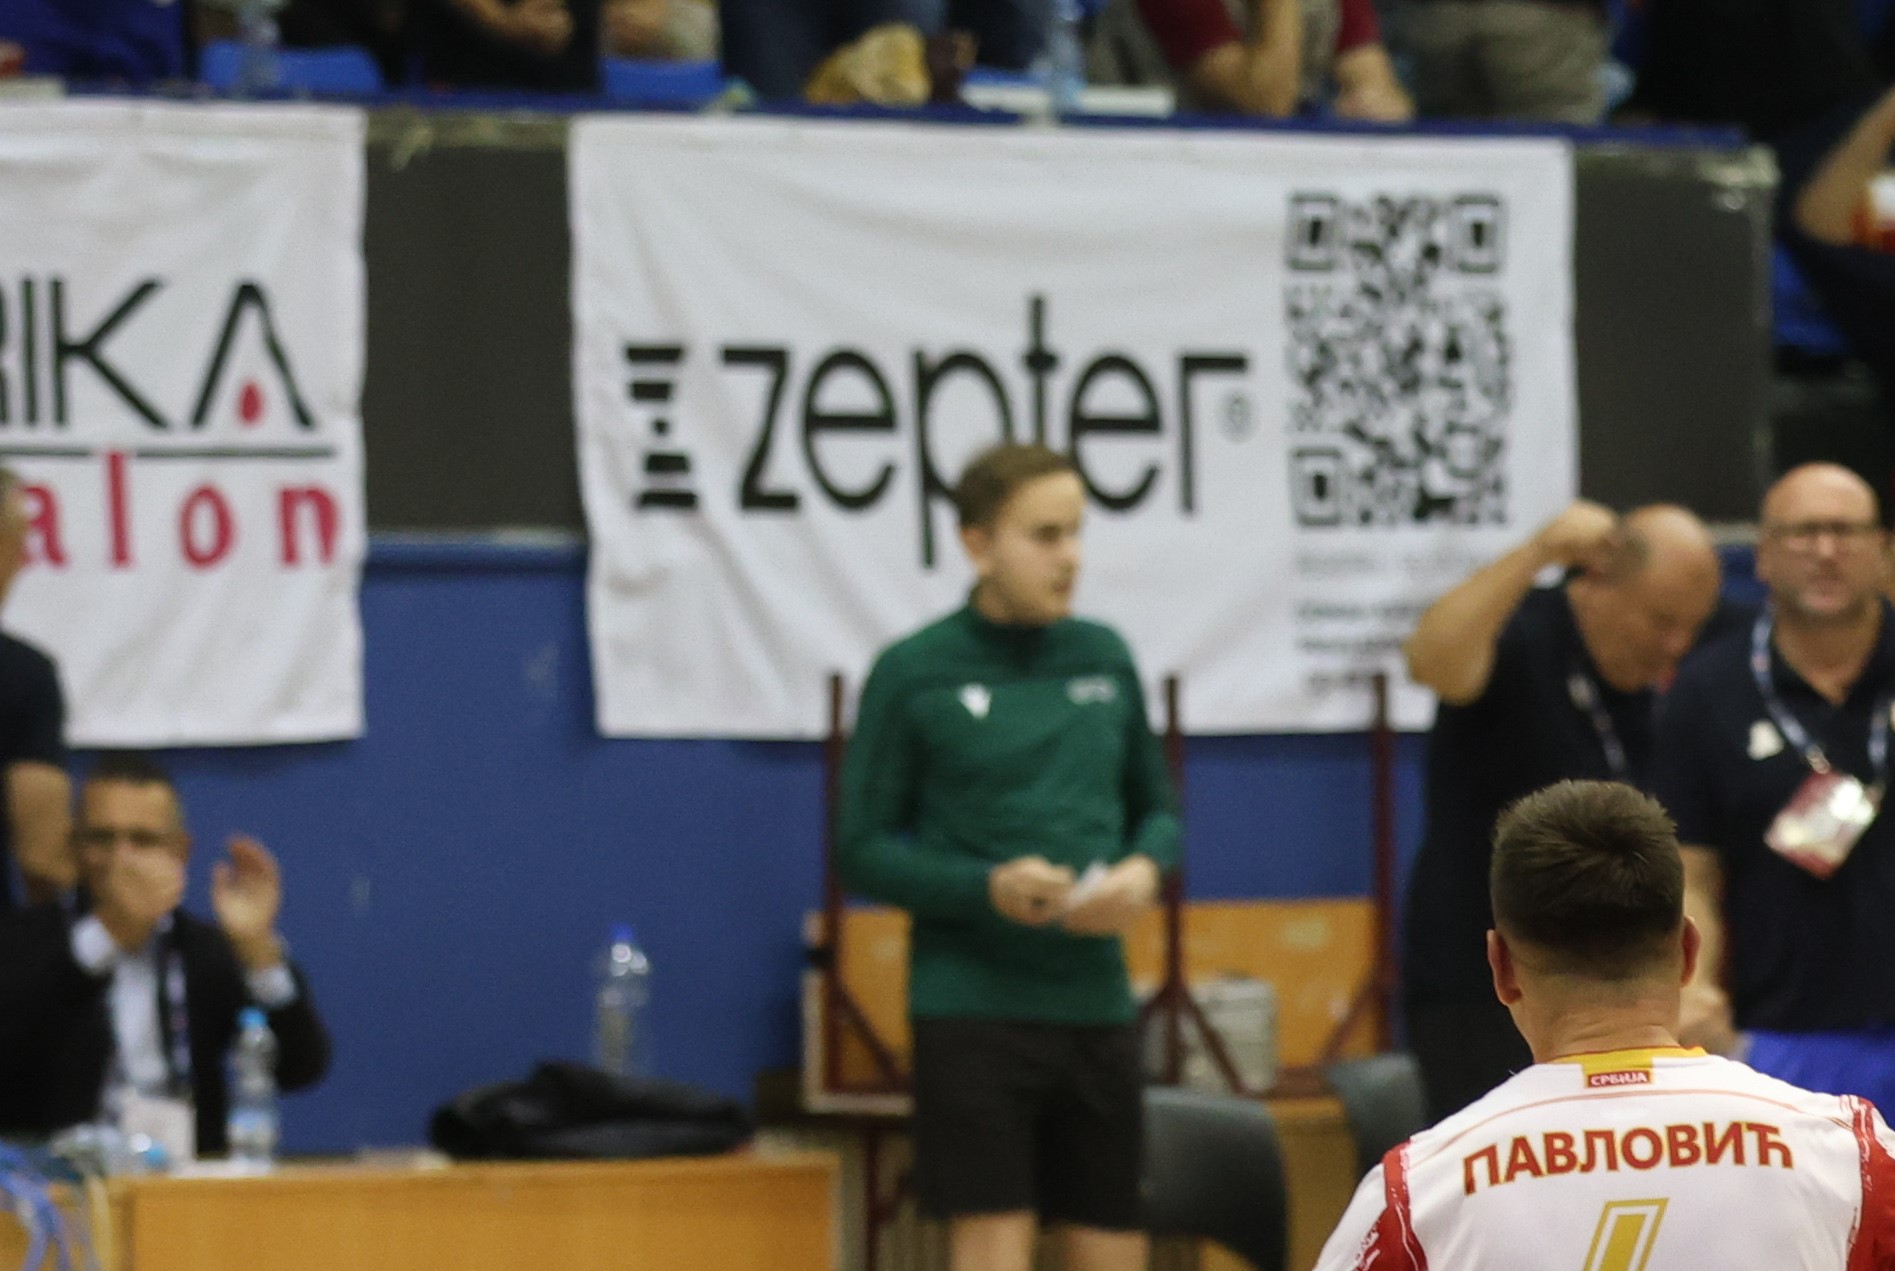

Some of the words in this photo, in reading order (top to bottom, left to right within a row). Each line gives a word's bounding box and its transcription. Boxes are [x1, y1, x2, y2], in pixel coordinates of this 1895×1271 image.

[0, 278, 317, 428] IKA
[719, 294, 1250, 568] zepter
[1462, 1120, 1795, 1197] ПАВЛОВИЋ
